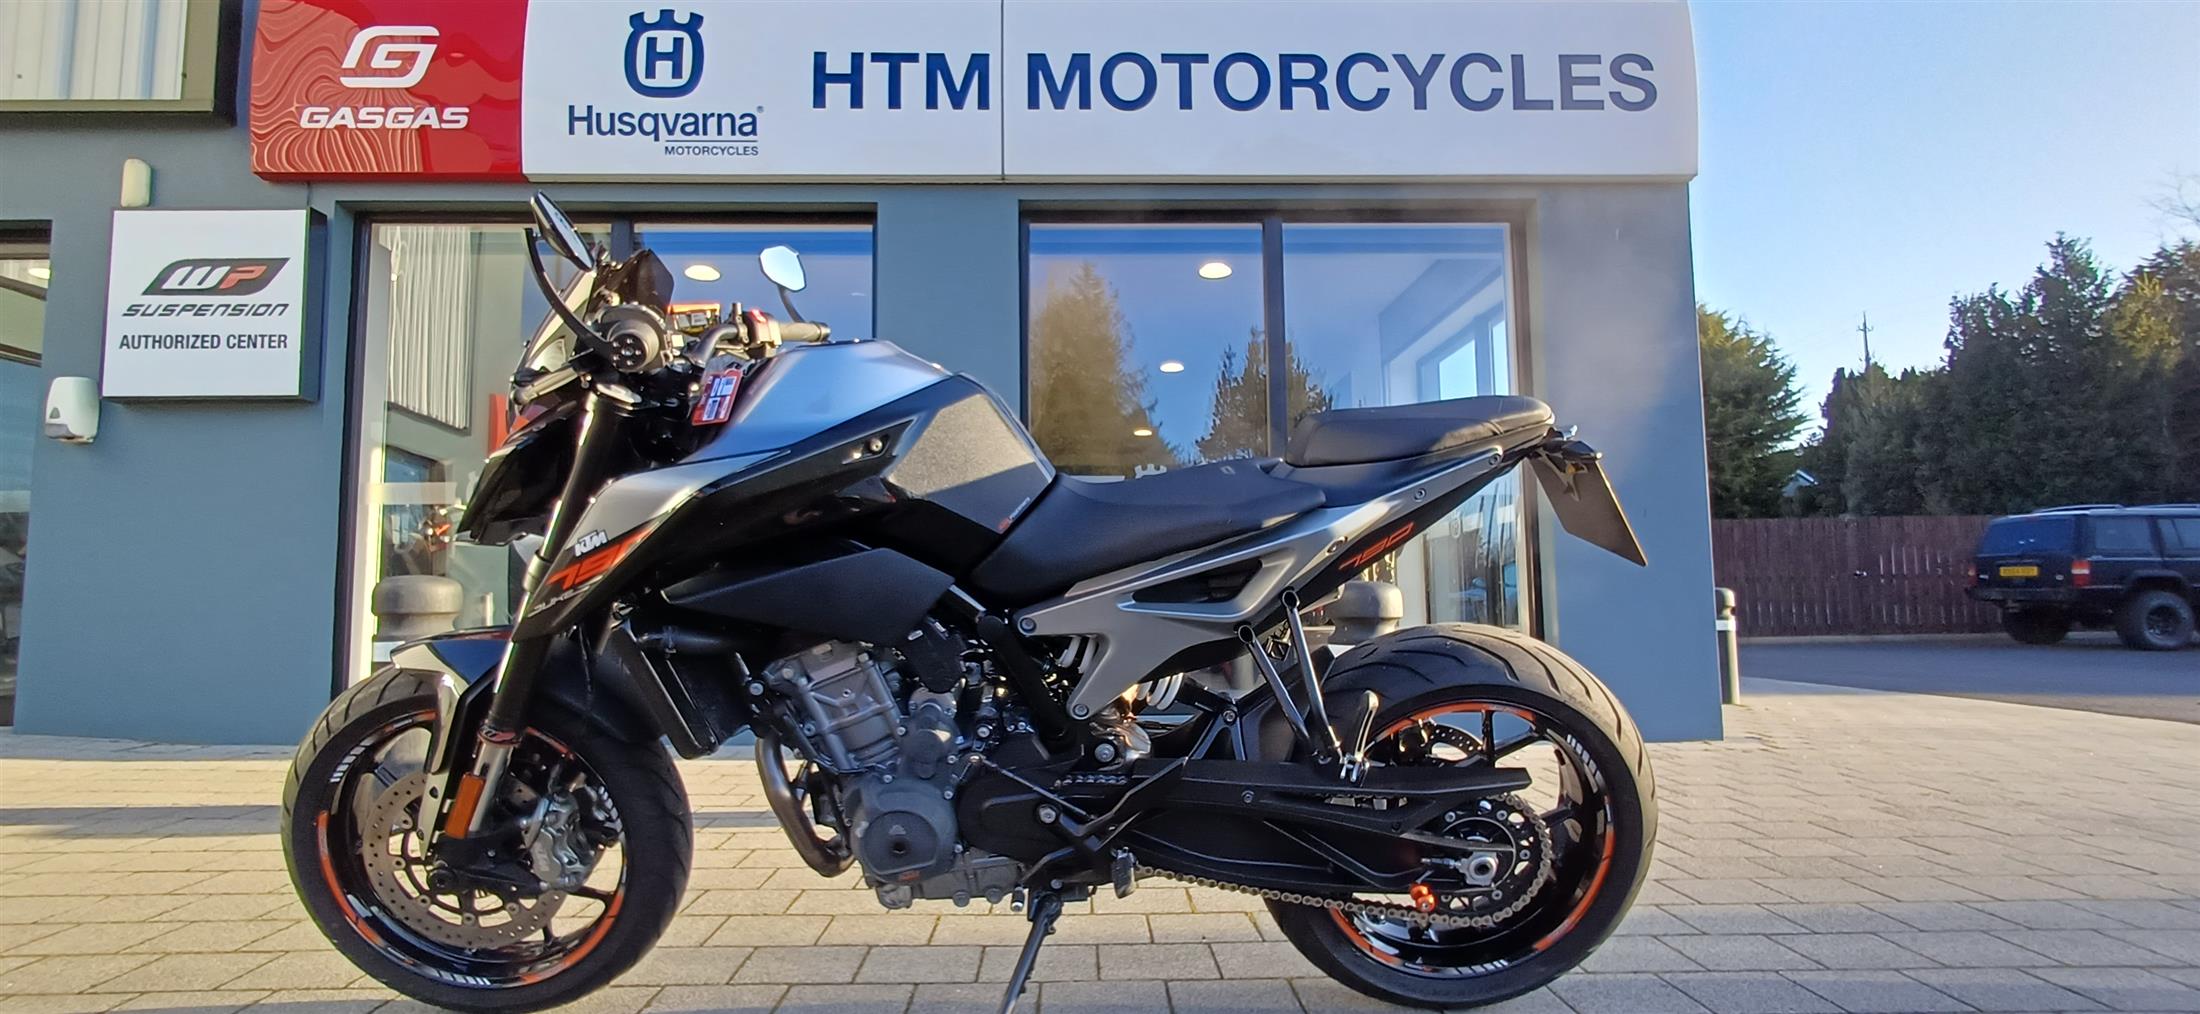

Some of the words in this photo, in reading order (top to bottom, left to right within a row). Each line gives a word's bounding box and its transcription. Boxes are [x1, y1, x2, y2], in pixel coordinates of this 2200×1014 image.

[812, 50, 991, 111] HTM
[1026, 50, 1658, 113] MOTORCYCLES
[299, 106, 470, 130] GASGAS
[568, 104, 758, 143] Husqvarna
[664, 145, 759, 157] MOTORCYCLES
[161, 265, 268, 291] WP
[121, 303, 290, 318] SUSPENSION
[118, 334, 222, 350] AUTHORIZED
[226, 334, 288, 350] CENTER
[574, 530, 609, 558] KTM
